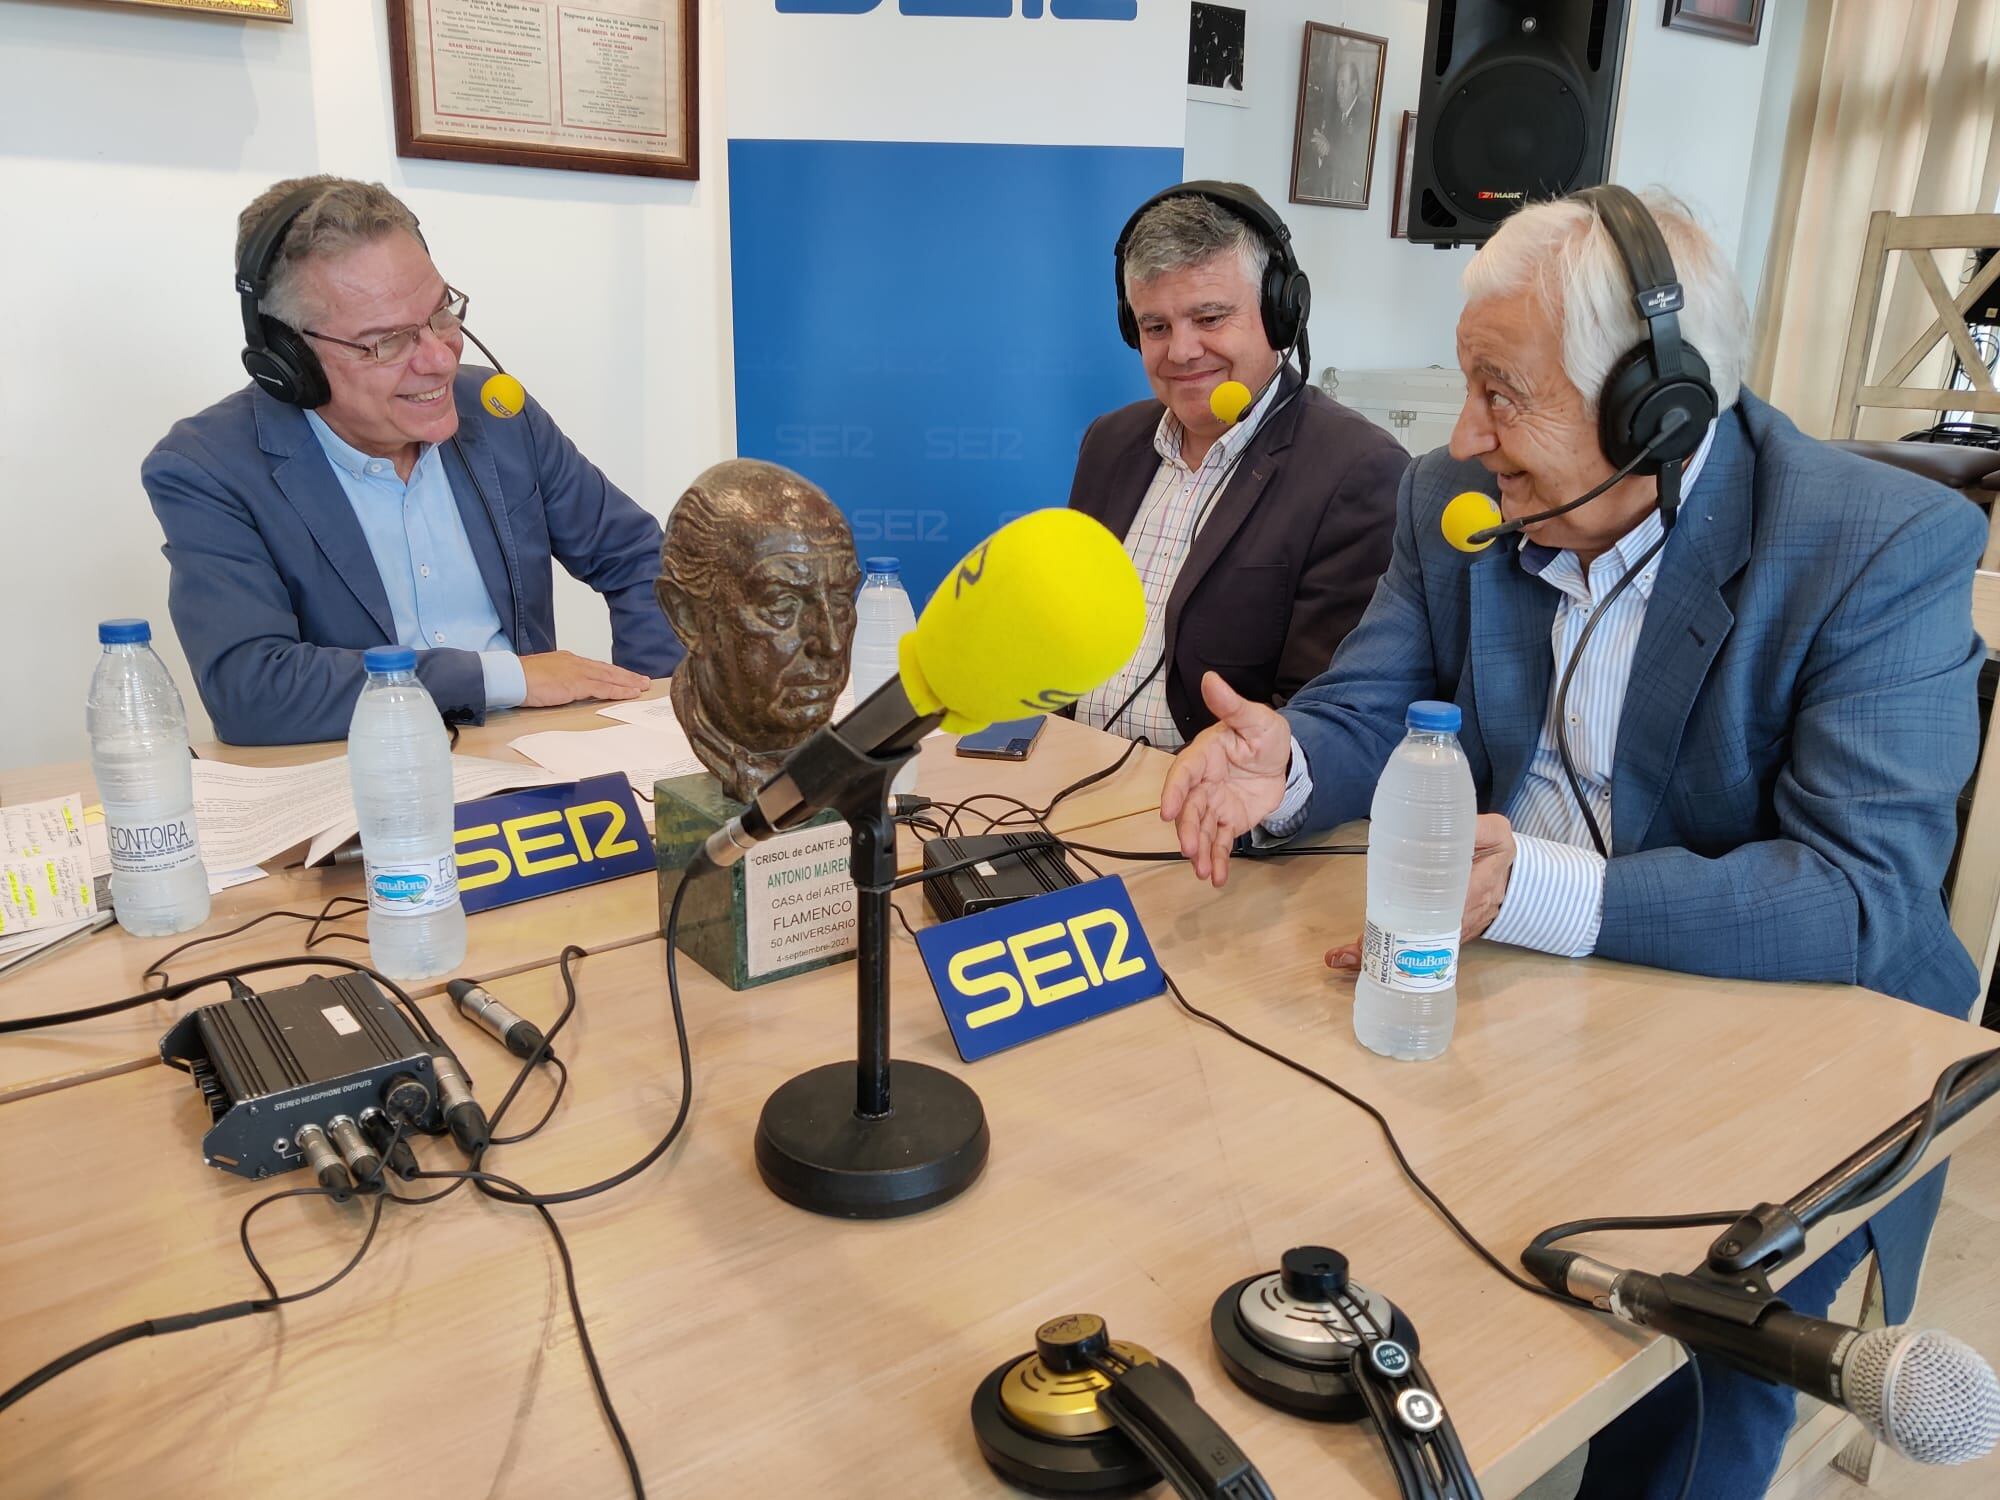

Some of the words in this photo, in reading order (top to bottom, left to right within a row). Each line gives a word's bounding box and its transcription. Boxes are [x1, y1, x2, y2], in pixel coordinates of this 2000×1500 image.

[852, 508, 949, 542] SER
[110, 820, 189, 851] FONTOIRA
[454, 800, 639, 891] SER
[792, 846, 803, 858] de
[805, 839, 835, 855] CANTE
[767, 865, 812, 889] ANTONIO
[814, 856, 851, 878] MAIREN
[771, 892, 804, 910] CASA
[806, 889, 822, 901] del
[824, 880, 854, 896] ARTE
[773, 900, 852, 931] FLAMENCO
[770, 937, 783, 949] 50
[785, 918, 857, 946] ANIVERSARIO
[948, 908, 1147, 1030] SER
[1398, 955, 1451, 968] aquaBona
[274, 1098, 300, 1111] STEREO
[301, 1087, 342, 1105] HEADPHONE
[342, 1079, 373, 1092] OUTPUTS
[1410, 1400, 1429, 1418] R
